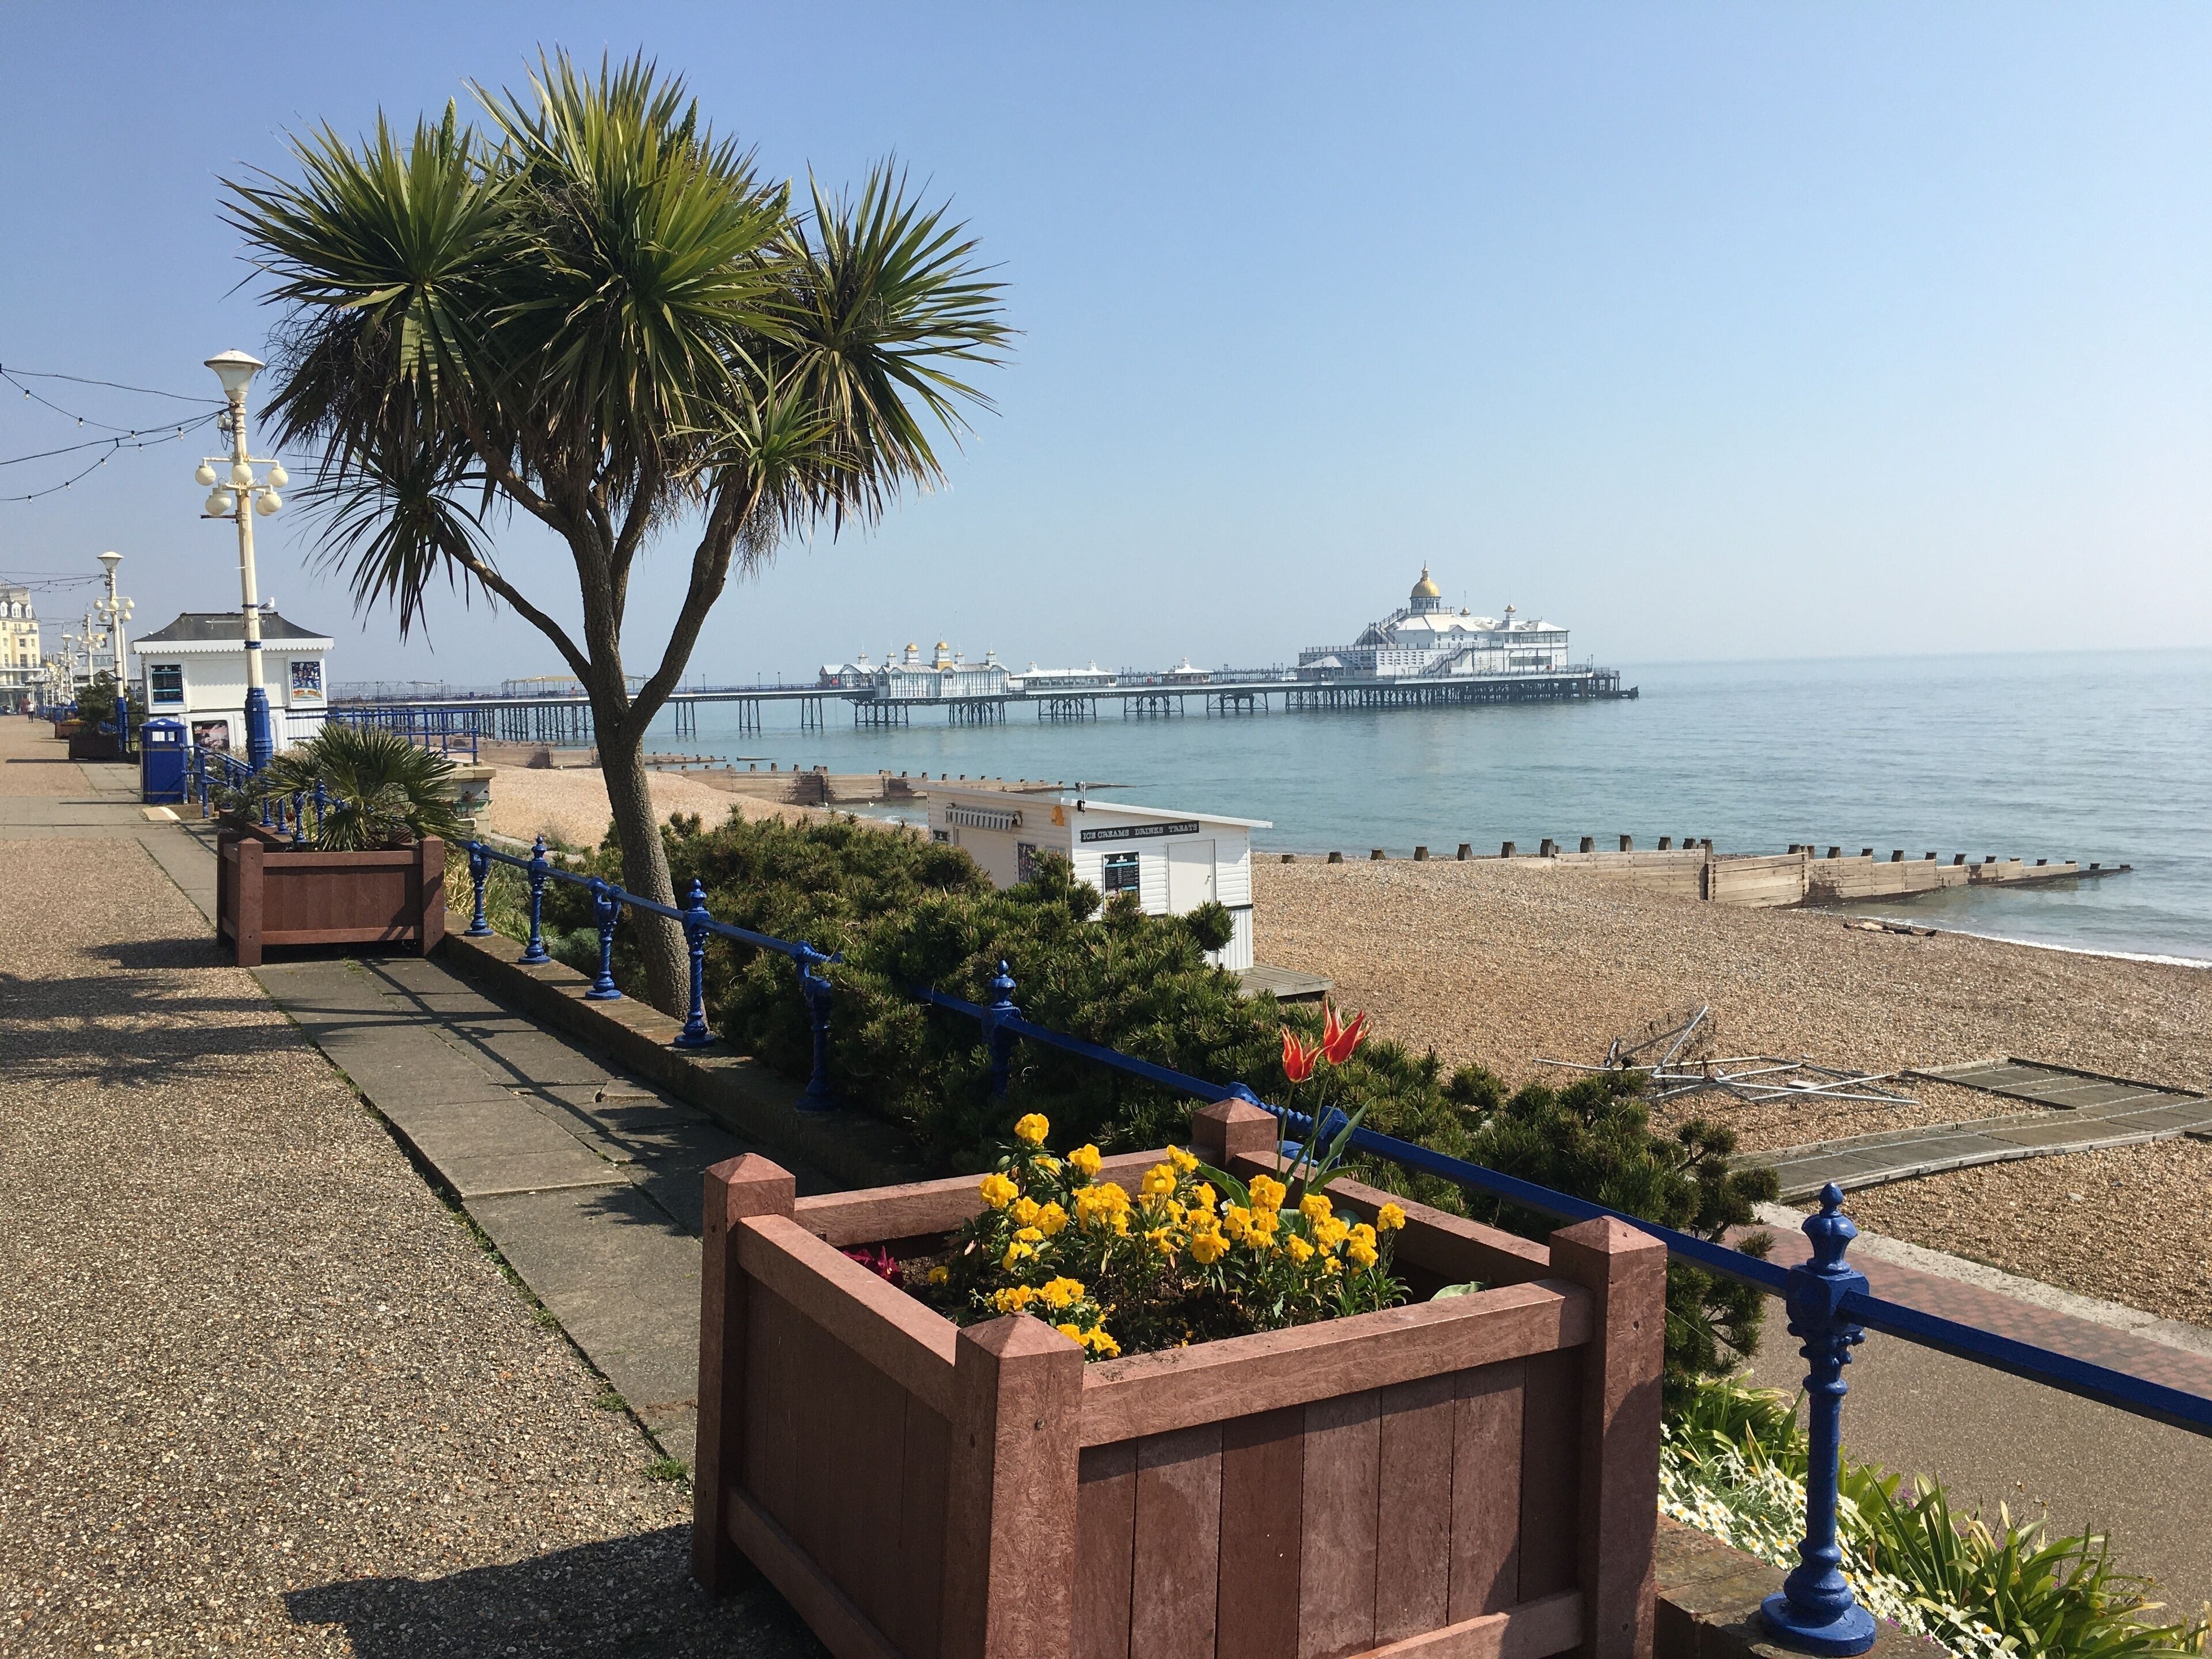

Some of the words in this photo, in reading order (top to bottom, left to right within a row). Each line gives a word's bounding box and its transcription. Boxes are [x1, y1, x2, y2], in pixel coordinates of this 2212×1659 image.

[1097, 830, 1129, 839] CREAMS
[1134, 827, 1163, 835] DRINKS
[1168, 824, 1198, 833] TREATS
